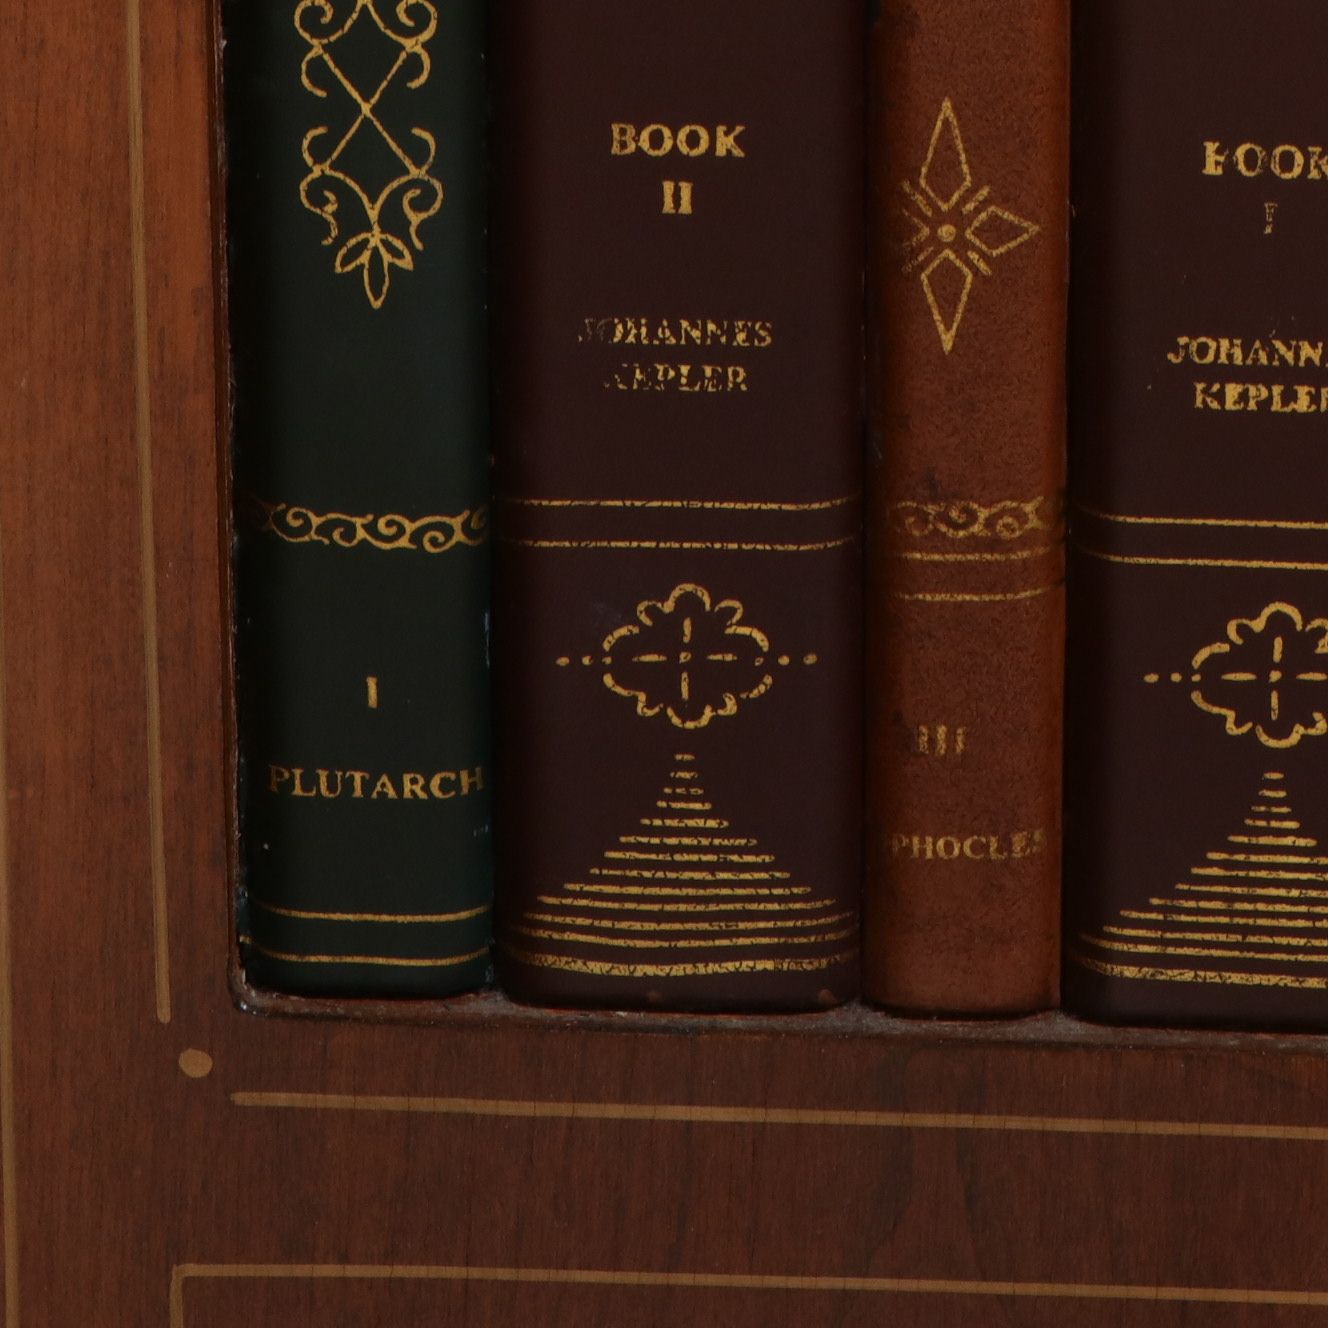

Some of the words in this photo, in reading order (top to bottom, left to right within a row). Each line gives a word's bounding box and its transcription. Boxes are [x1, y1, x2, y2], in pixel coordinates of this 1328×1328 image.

[610, 123, 746, 158] BOOK
[662, 180, 693, 215] II
[918, 725, 966, 756] III
[269, 765, 484, 800] PLUTARCH
